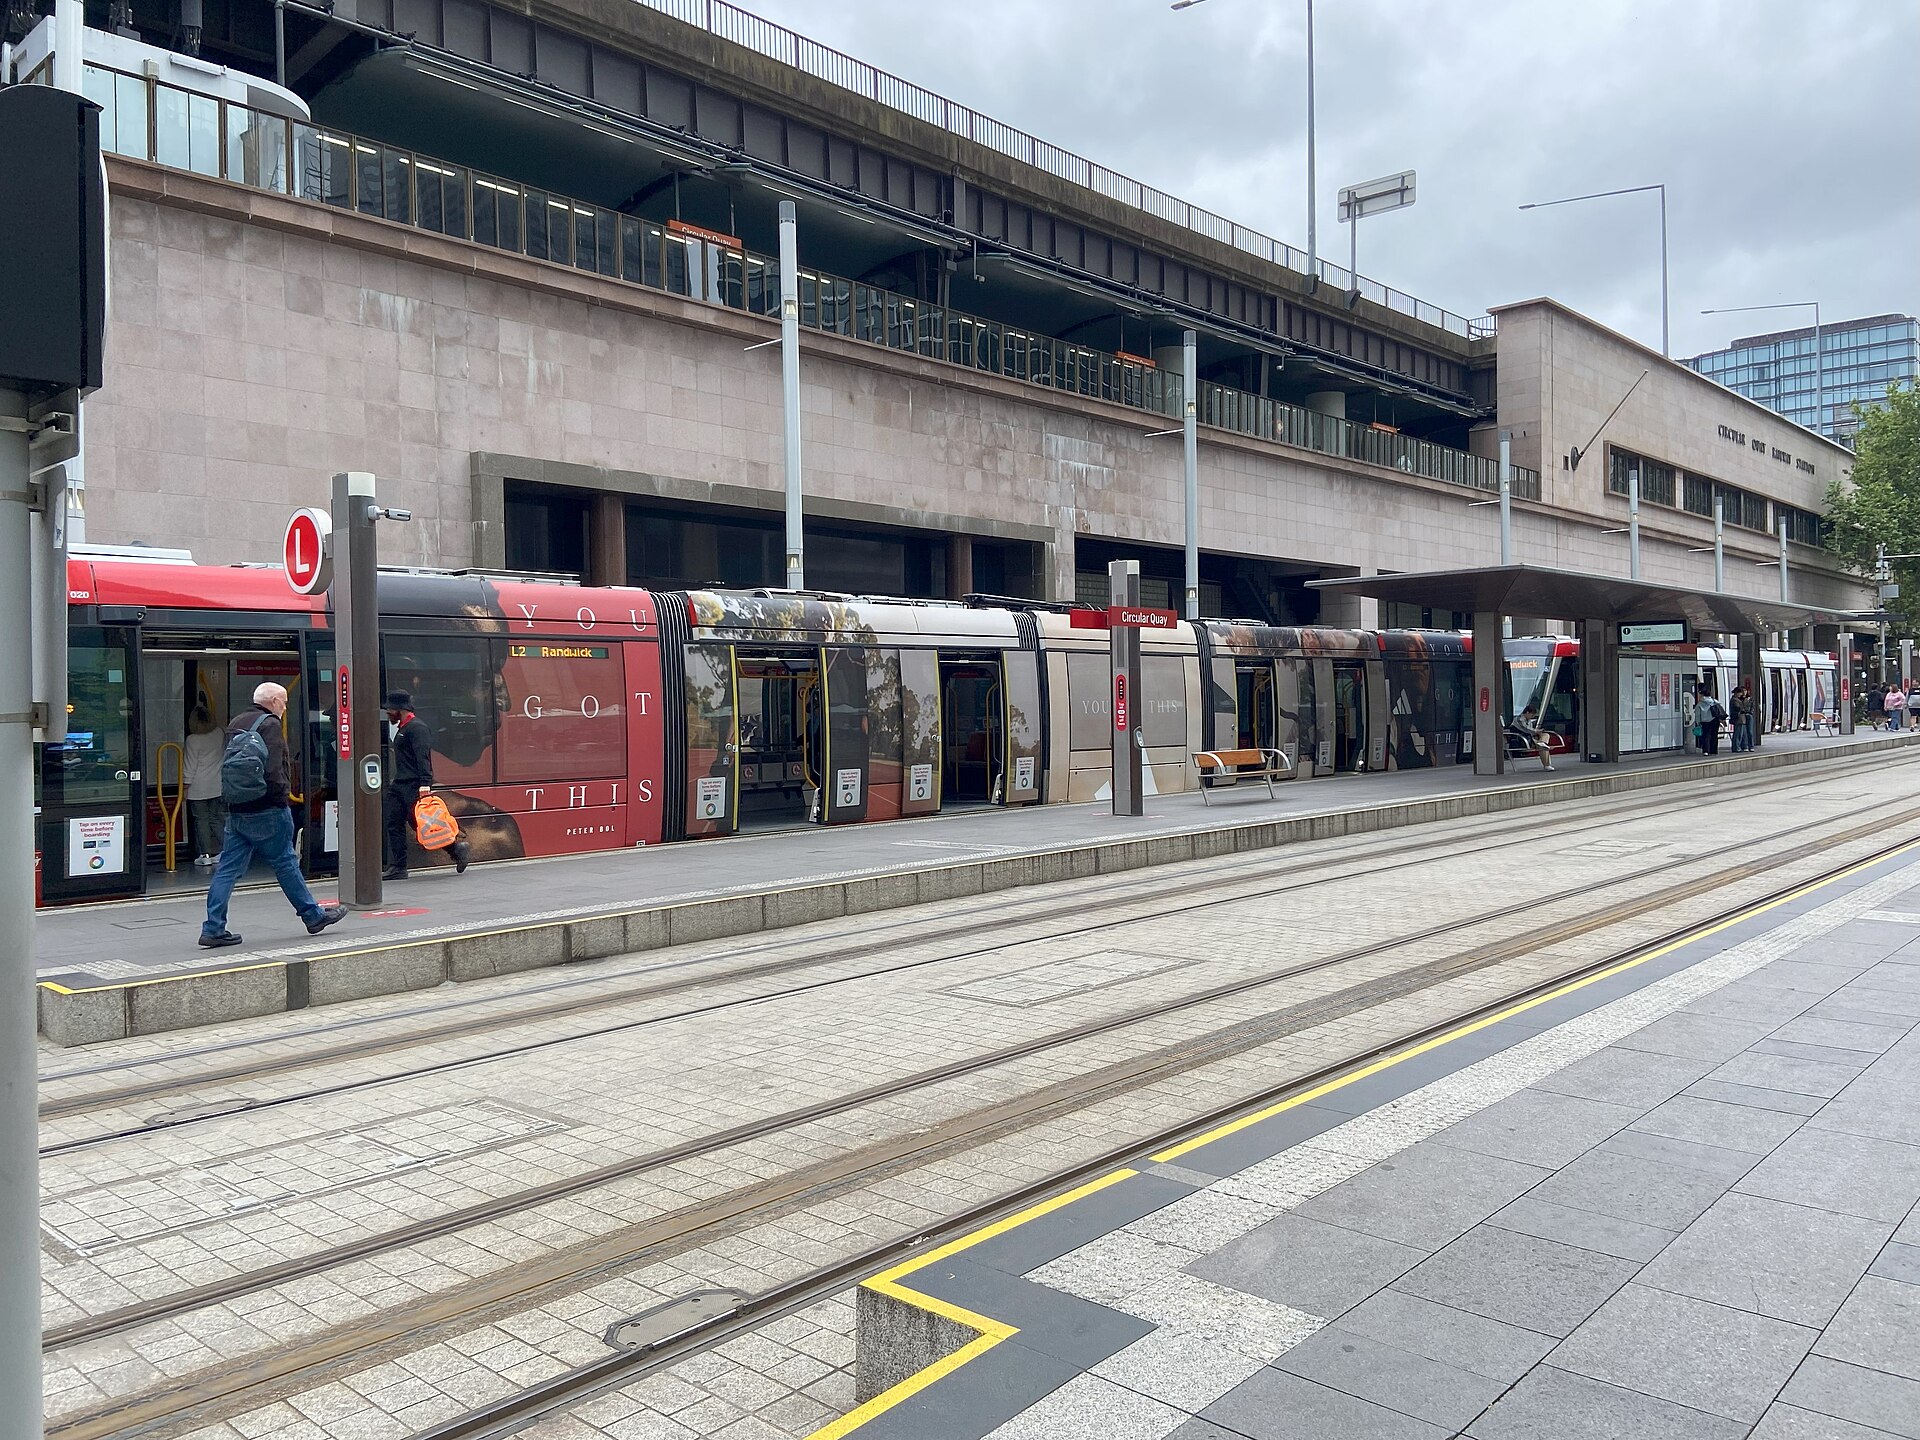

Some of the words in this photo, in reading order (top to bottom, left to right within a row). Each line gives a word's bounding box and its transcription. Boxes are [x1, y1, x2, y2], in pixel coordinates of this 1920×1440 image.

[295, 528, 310, 574] L
[517, 603, 647, 632] YOU
[1121, 611, 1149, 623] Circular
[1150, 613, 1168, 626] Quay
[511, 646, 527, 657] L2
[541, 647, 593, 658] Randwick
[523, 692, 652, 719] GOT
[1082, 700, 1109, 714] YOU
[1148, 700, 1178, 713] THIS
[525, 779, 653, 812] THIS
[567, 827, 594, 836] PETER
